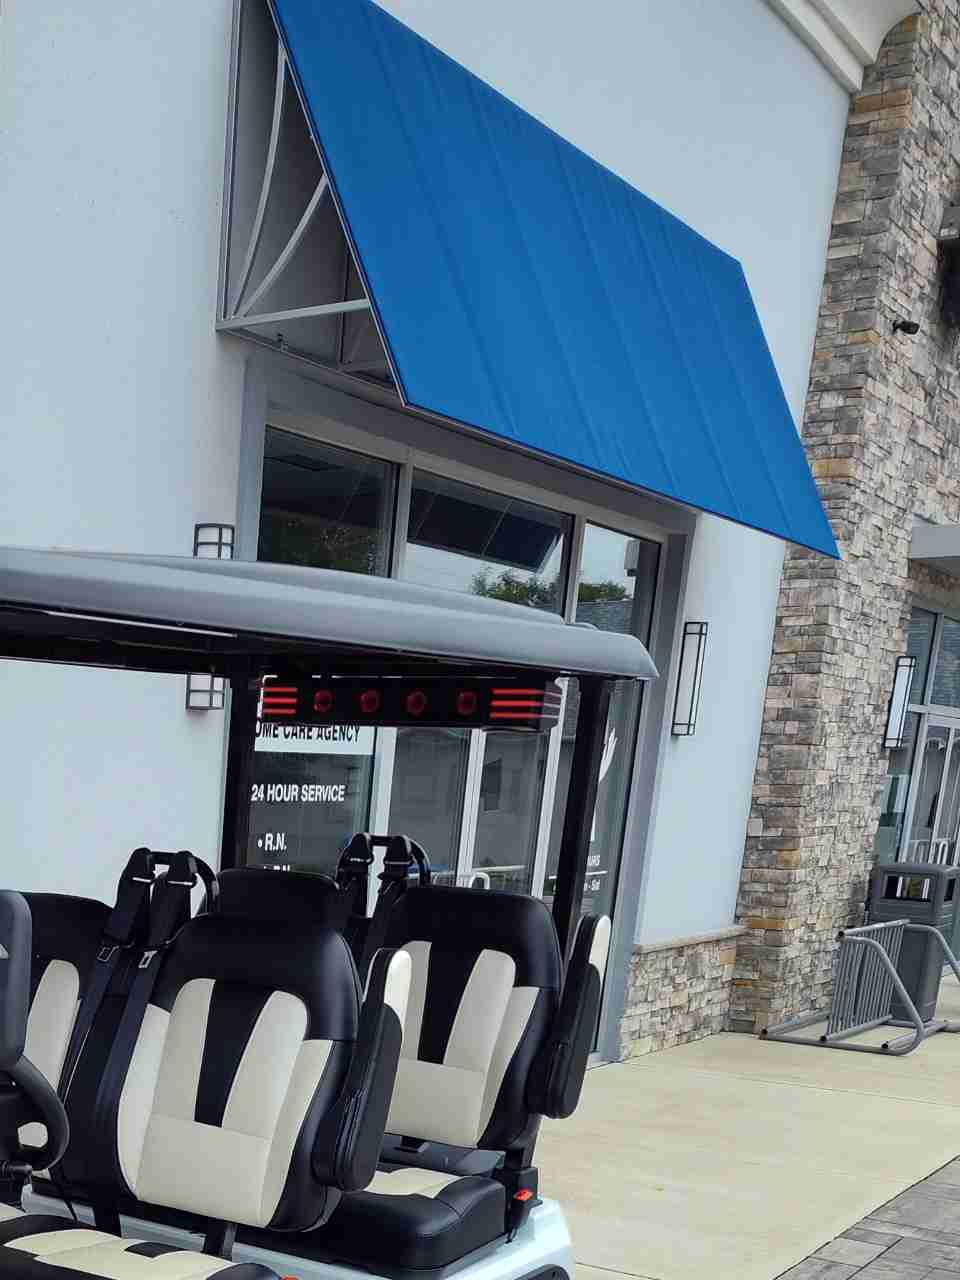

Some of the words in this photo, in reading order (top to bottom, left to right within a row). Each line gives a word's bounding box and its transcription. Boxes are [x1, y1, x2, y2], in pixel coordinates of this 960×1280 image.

[255, 722, 279, 738] OME
[283, 725, 313, 740] CARE
[316, 726, 360, 742] AGENCY
[251, 784, 265, 801] 24
[267, 784, 299, 801] HOUR
[301, 784, 345, 801] SERVICE
